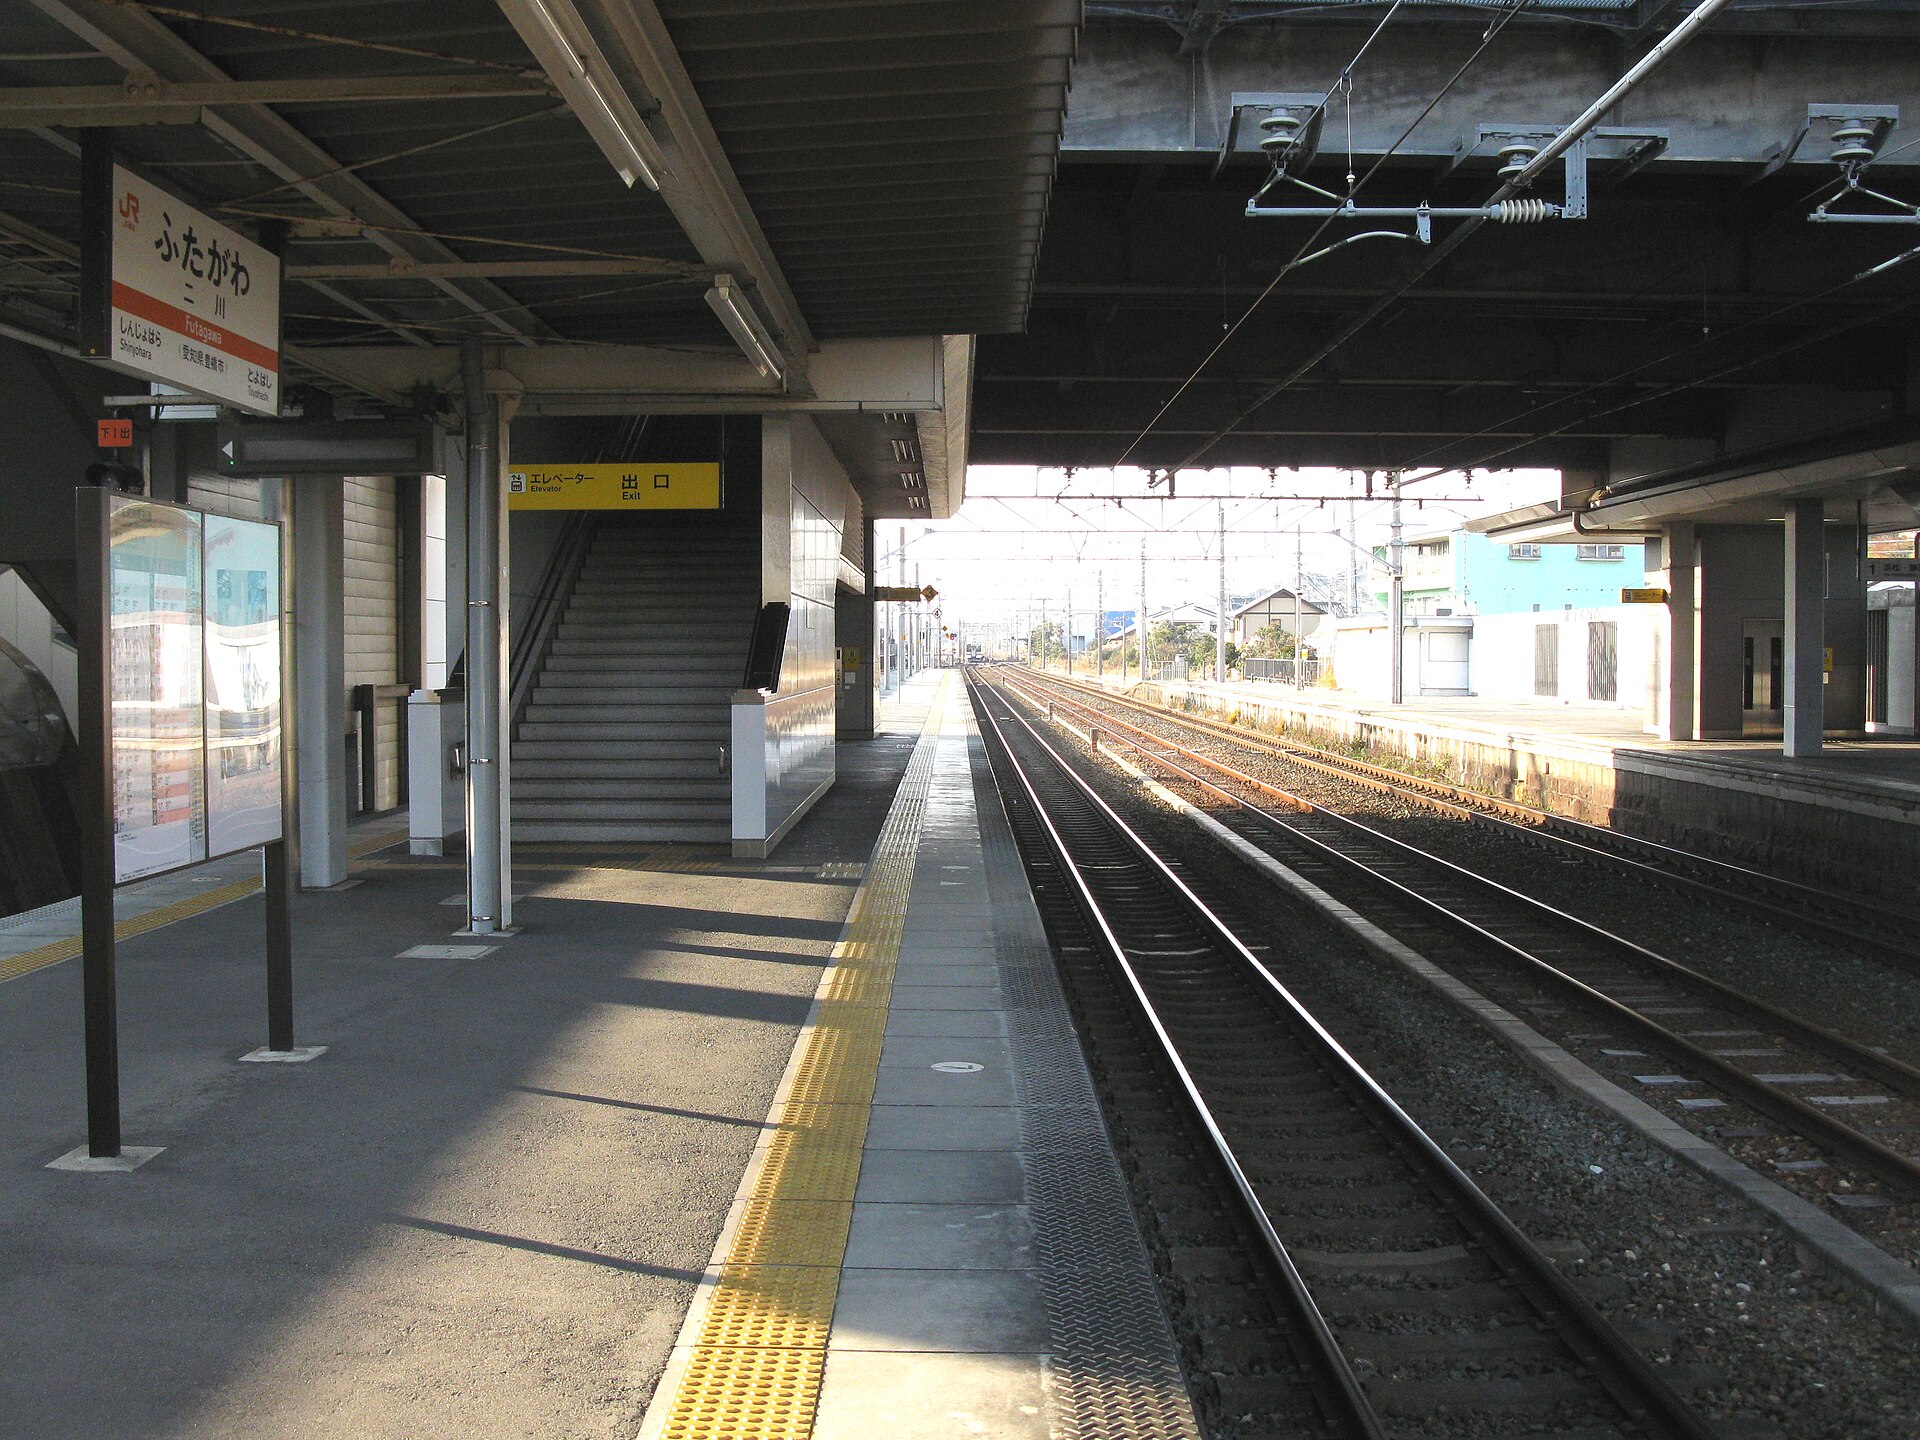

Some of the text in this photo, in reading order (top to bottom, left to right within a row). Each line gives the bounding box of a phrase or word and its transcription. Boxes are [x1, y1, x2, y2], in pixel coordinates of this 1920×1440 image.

[119, 192, 139, 224] JR
[155, 211, 250, 297] ふたがわ
[184, 282, 226, 319] 二川
[120, 316, 162, 348] しんじょはら
[185, 315, 222, 345] Futagawa
[120, 341, 152, 361] Shinjohara
[247, 367, 272, 389] とよはし
[530, 473, 594, 484] エレベーター
[530, 485, 562, 493] Elevator
[621, 474, 670, 490] 出口
[622, 491, 641, 500] Exit
[1869, 564, 1875, 575] 1
